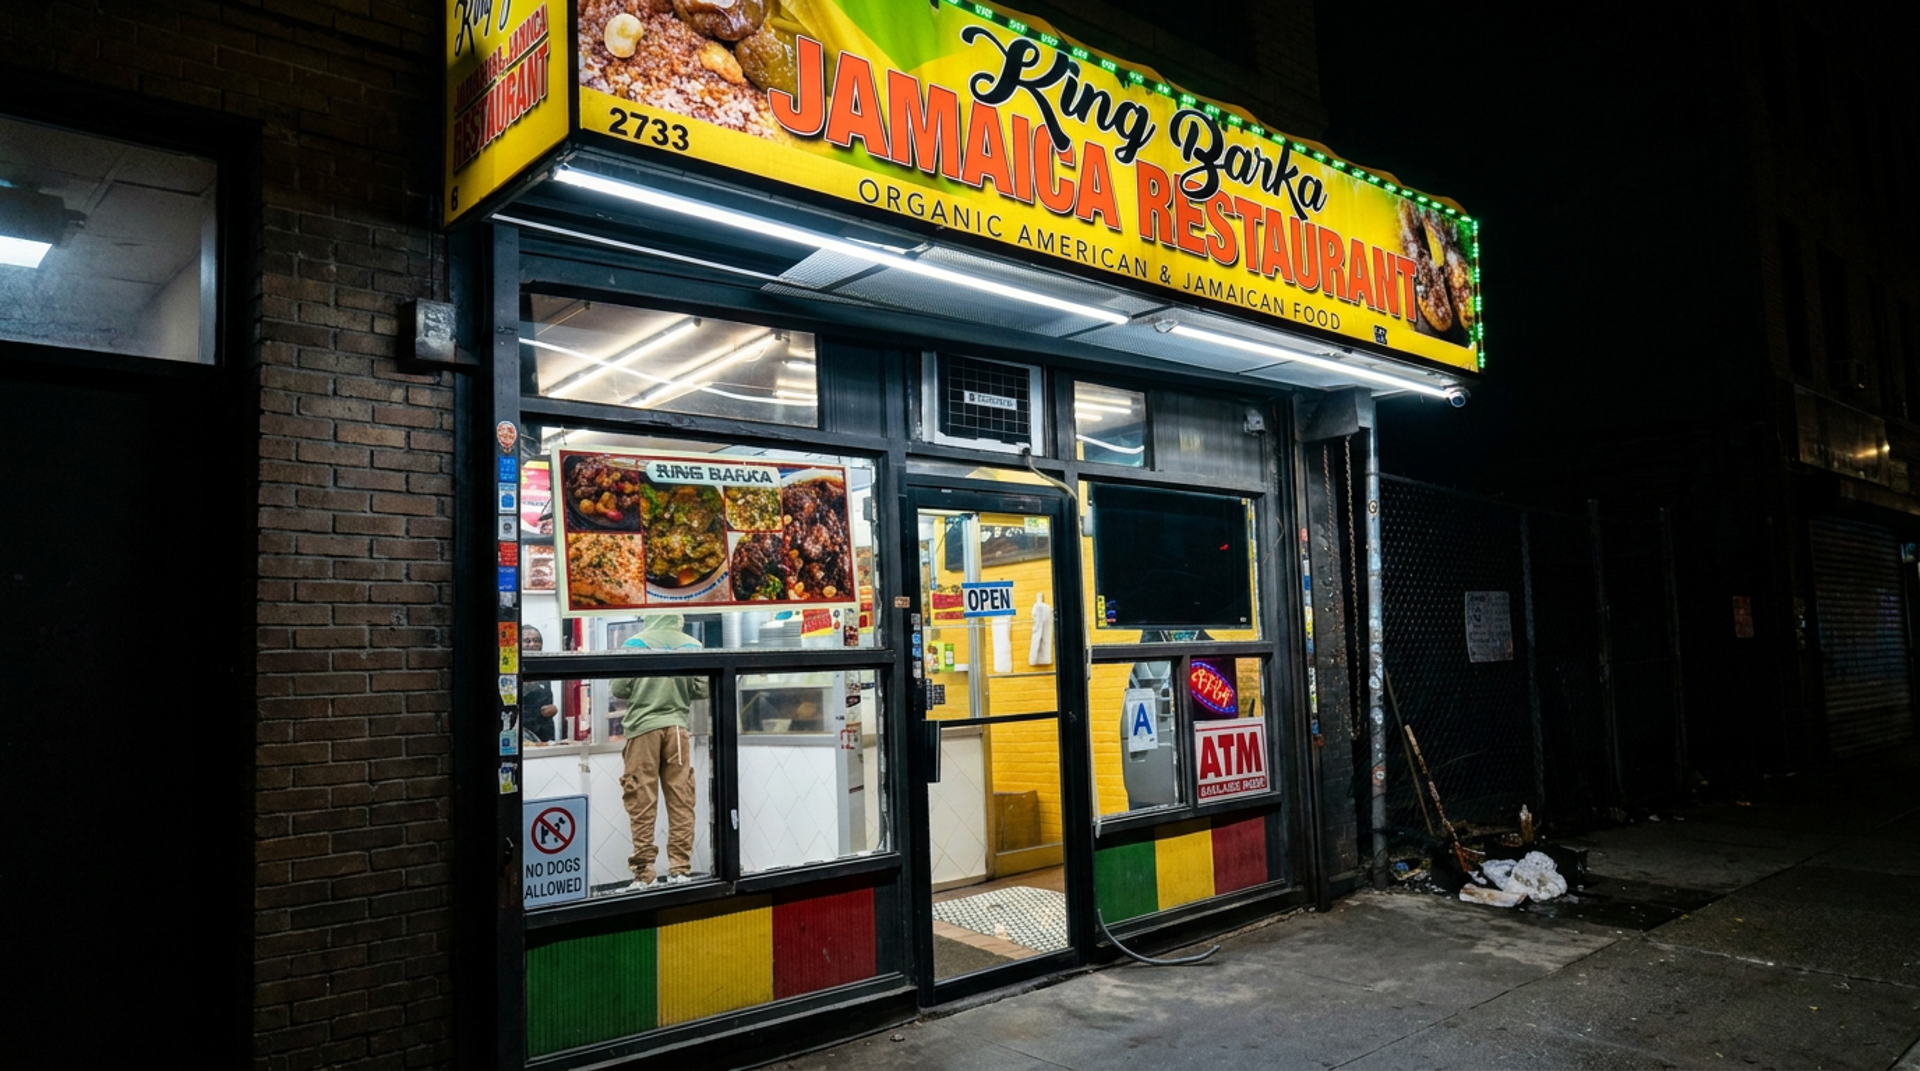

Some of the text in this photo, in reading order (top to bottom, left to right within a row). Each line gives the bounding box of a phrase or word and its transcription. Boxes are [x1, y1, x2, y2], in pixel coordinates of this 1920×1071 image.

[453, 41, 547, 172] RESTAURANT
[608, 107, 690, 151] 2733
[961, 25, 1327, 220] King Barka
[768, 34, 1418, 322] JAMAICA RESTAURANT
[858, 178, 1341, 330] ORGANIC AMERICAN & JAMAICAN FOOD
[968, 589, 1011, 611] OPEN
[1133, 703, 1153, 737] A
[1200, 732, 1262, 780] ATM
[524, 877, 582, 899] ALLOWED
[525, 858, 581, 878] NO DOGS
